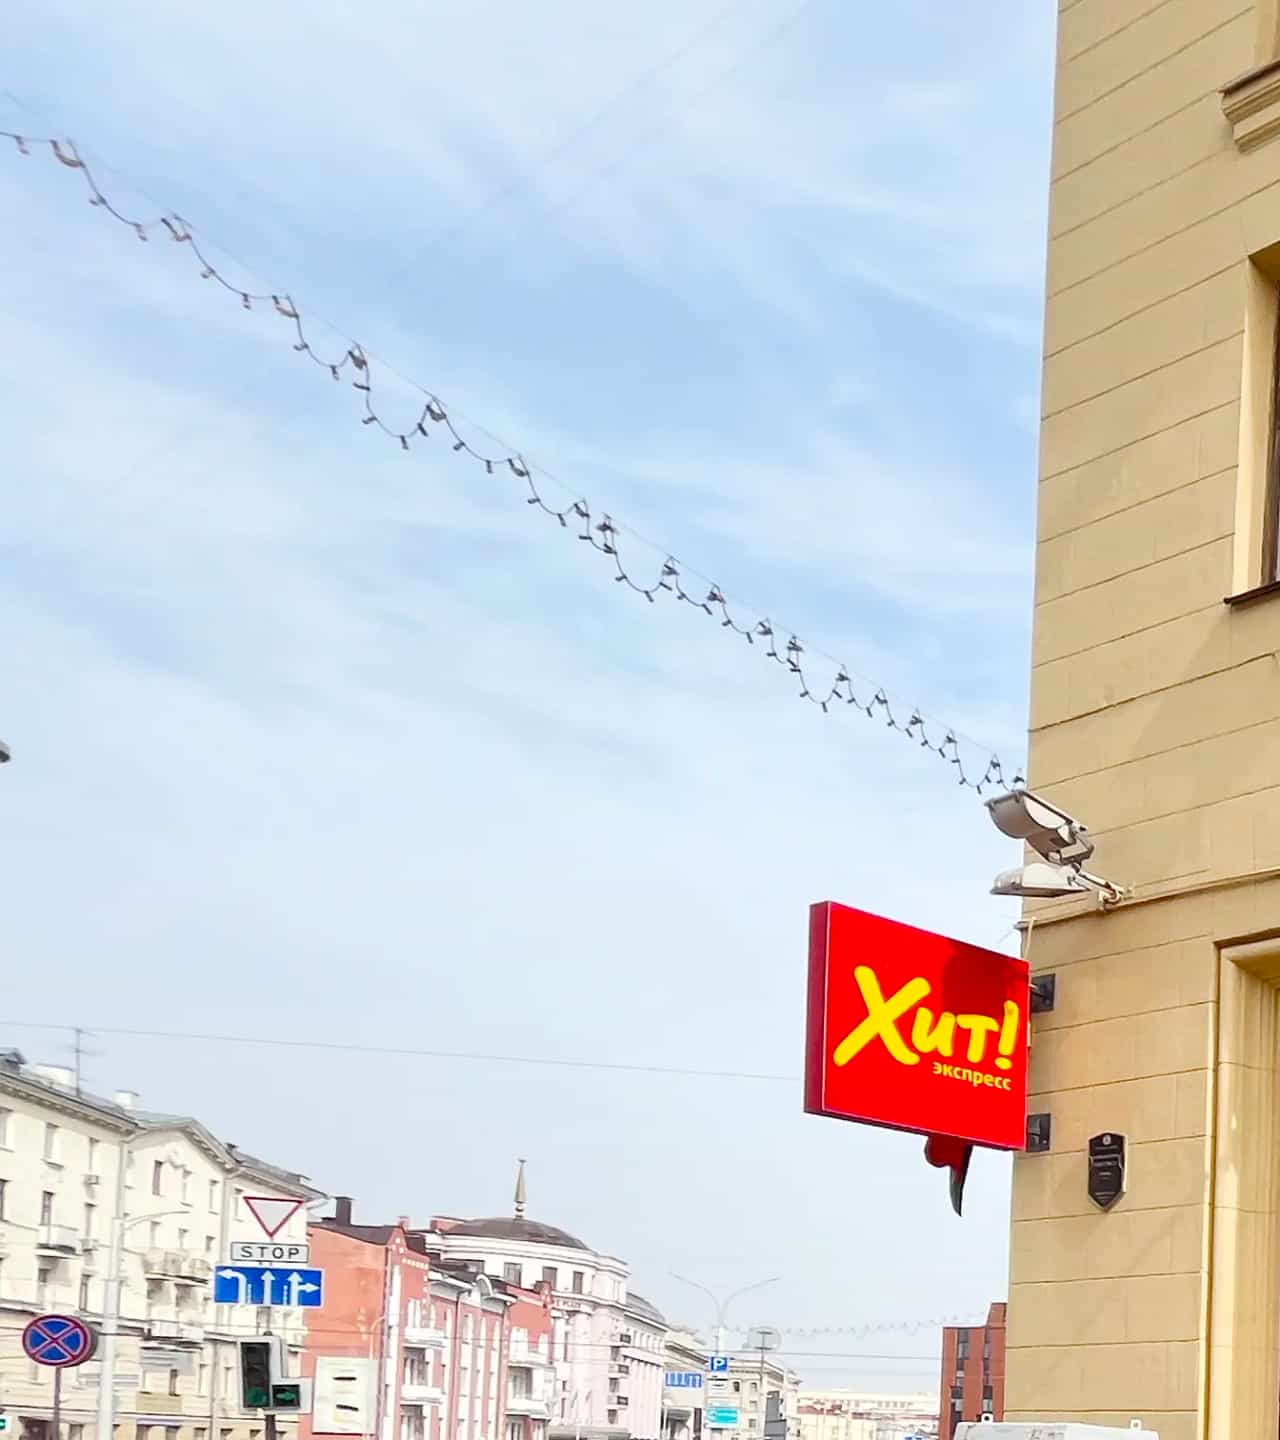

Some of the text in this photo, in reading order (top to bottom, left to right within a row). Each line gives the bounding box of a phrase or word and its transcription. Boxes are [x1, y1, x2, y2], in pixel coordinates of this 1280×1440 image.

[833, 965, 1019, 1070] Хит!
[932, 1062, 1012, 1091] экспресс
[241, 1246, 300, 1259] STOP
